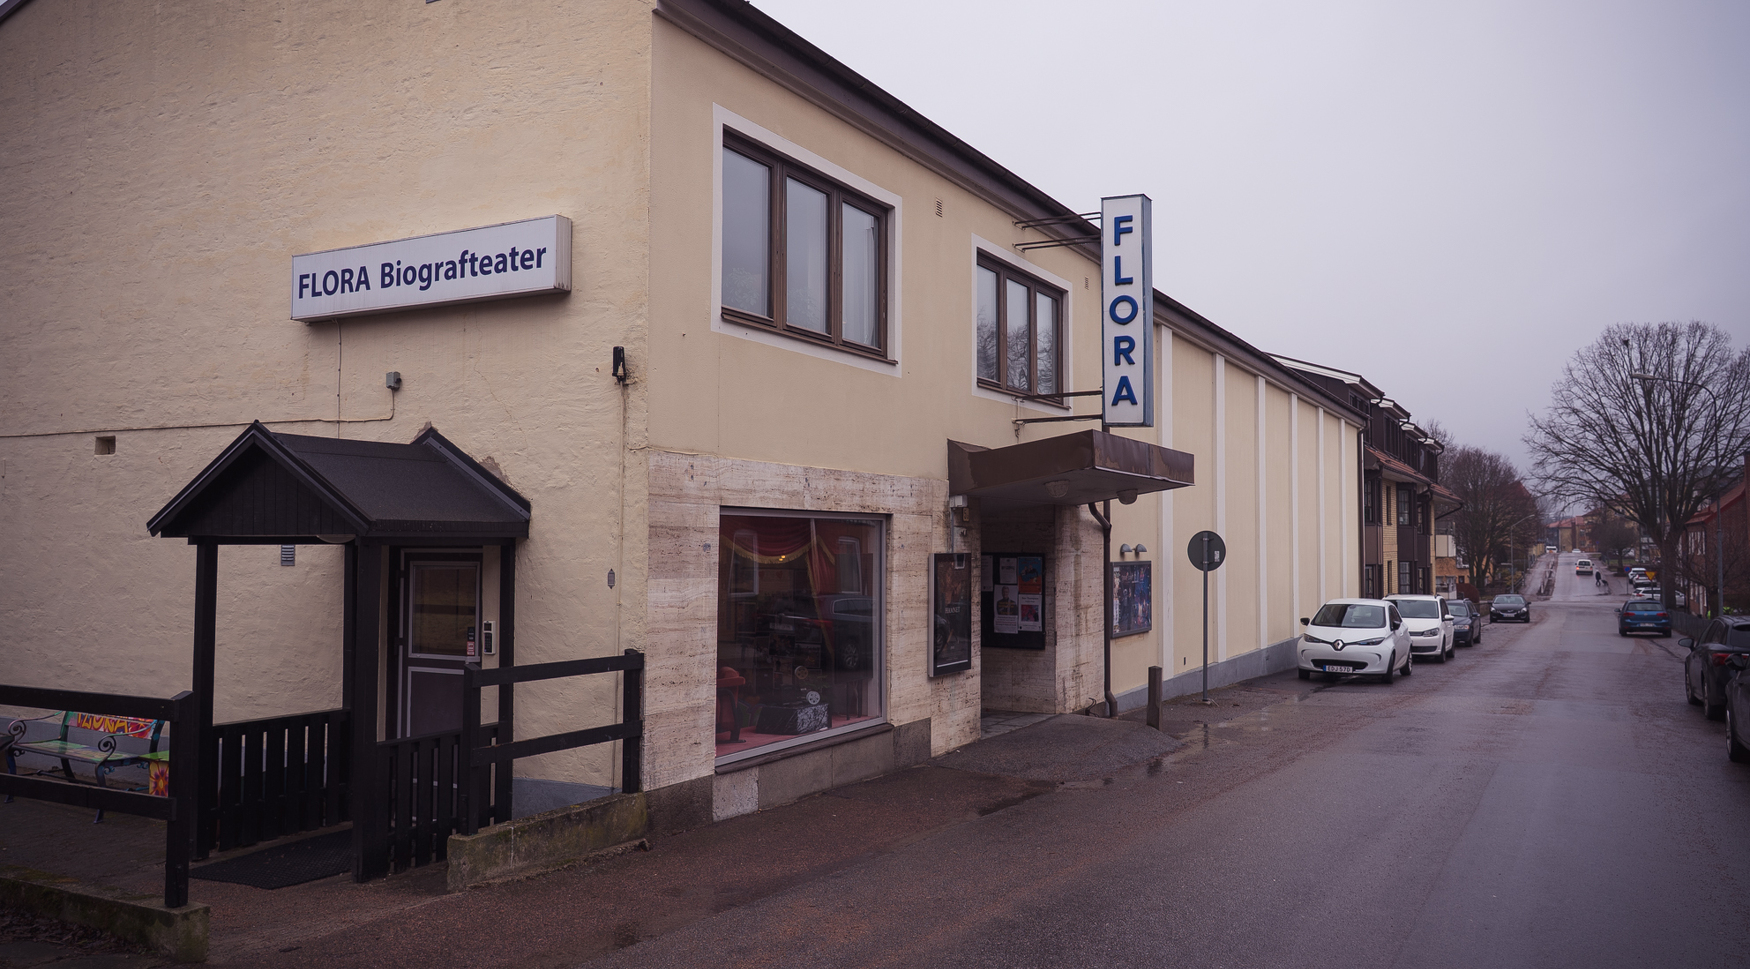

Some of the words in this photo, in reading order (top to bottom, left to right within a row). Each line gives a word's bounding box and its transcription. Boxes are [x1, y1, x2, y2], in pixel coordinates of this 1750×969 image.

[298, 265, 371, 299] FLORA
[380, 246, 547, 291] Biografteater
[1109, 215, 1139, 406] FLORA
